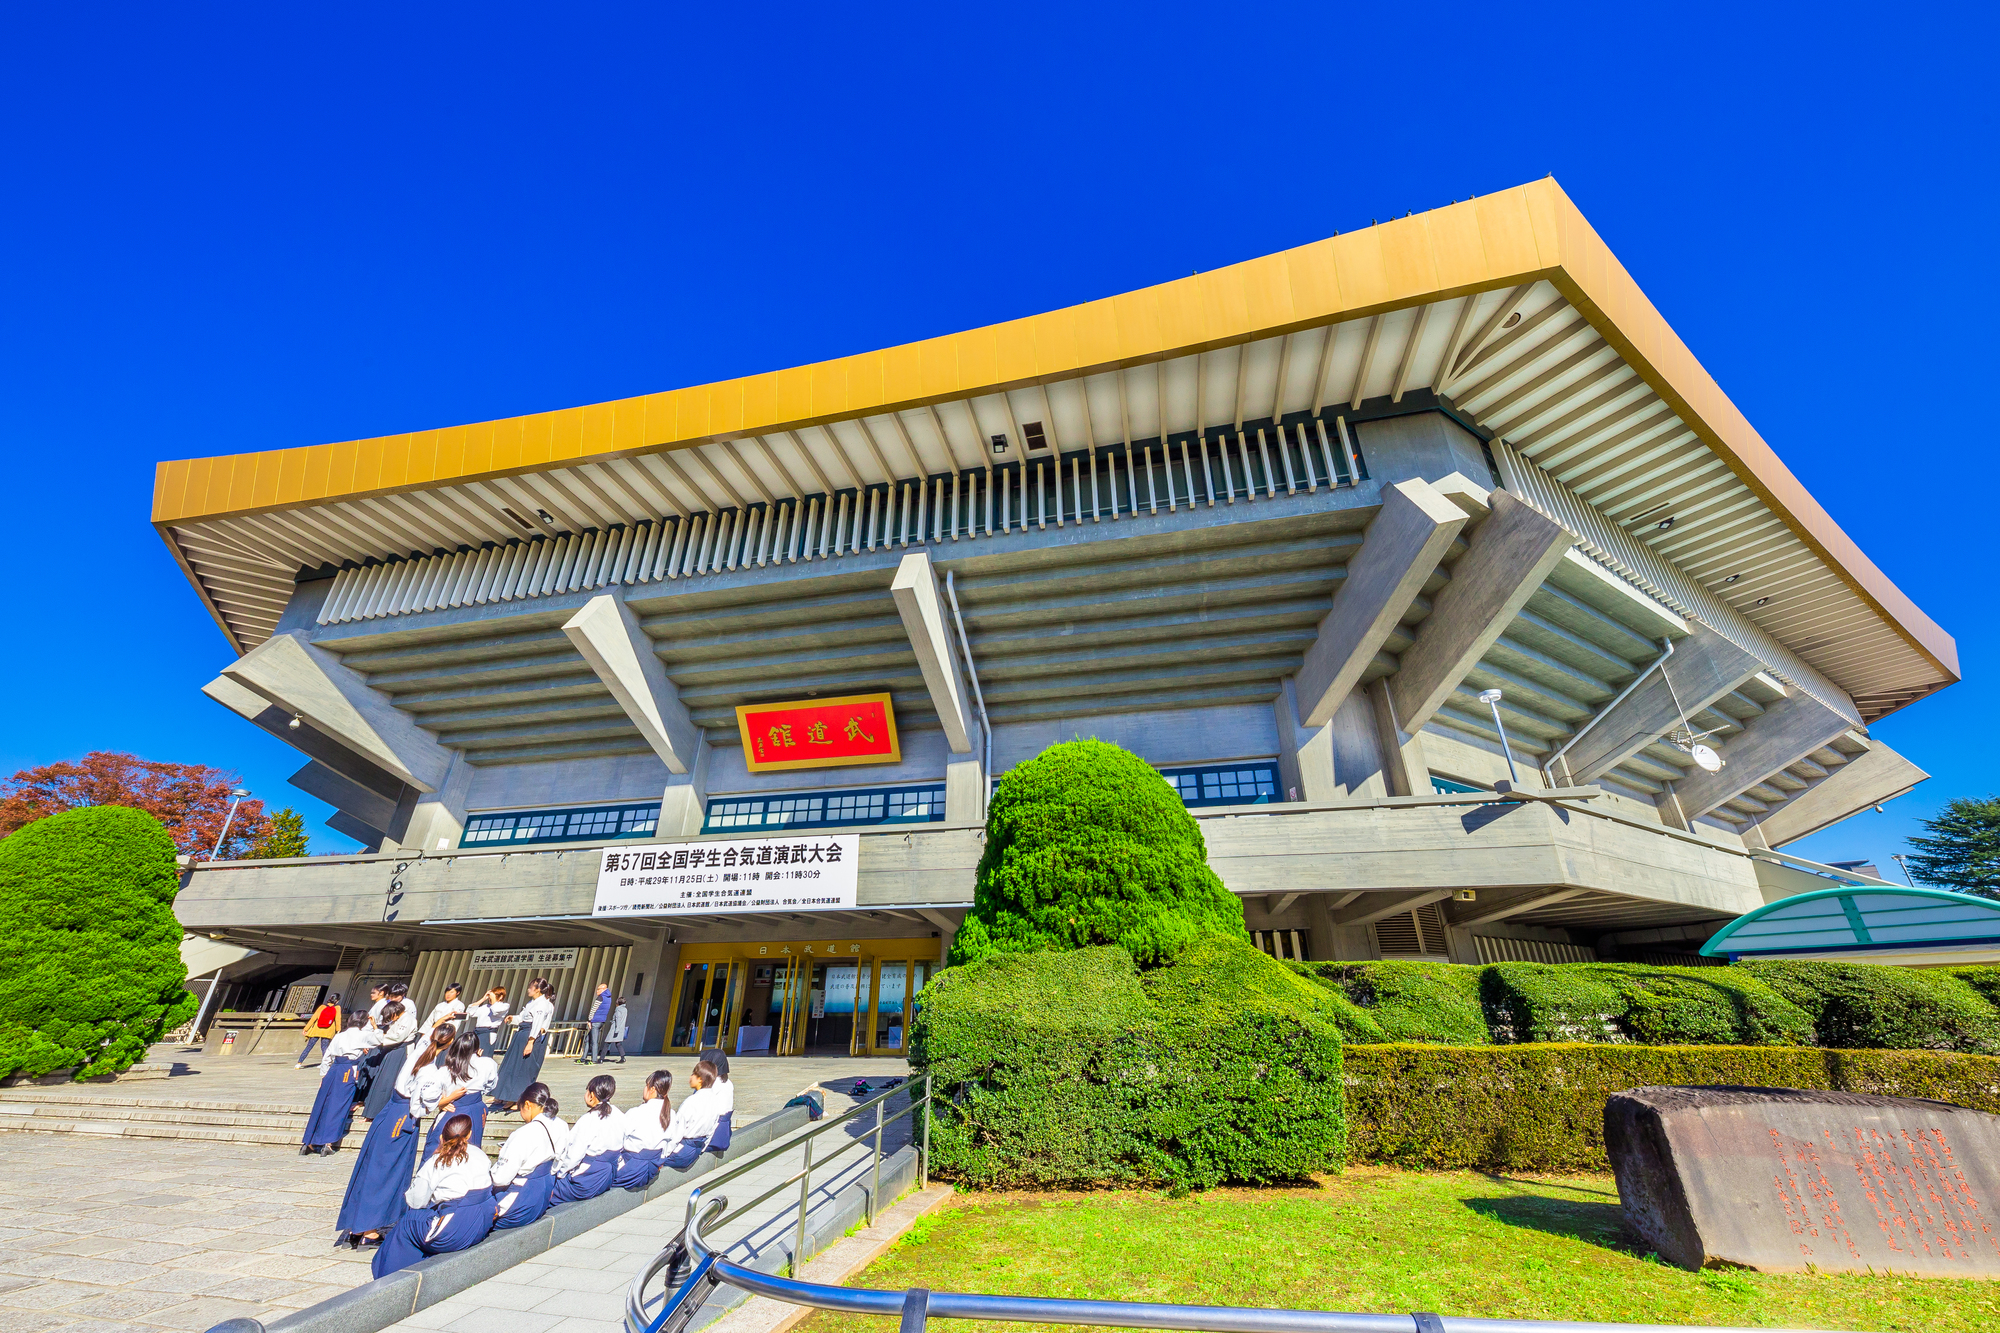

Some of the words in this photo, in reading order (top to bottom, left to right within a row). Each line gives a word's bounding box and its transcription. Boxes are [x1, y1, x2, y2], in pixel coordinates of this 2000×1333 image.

[768, 715, 875, 748] 武道館
[604, 842, 843, 873] 第57回全国学生合気道演武大会
[759, 943, 861, 955] 日本武道館
